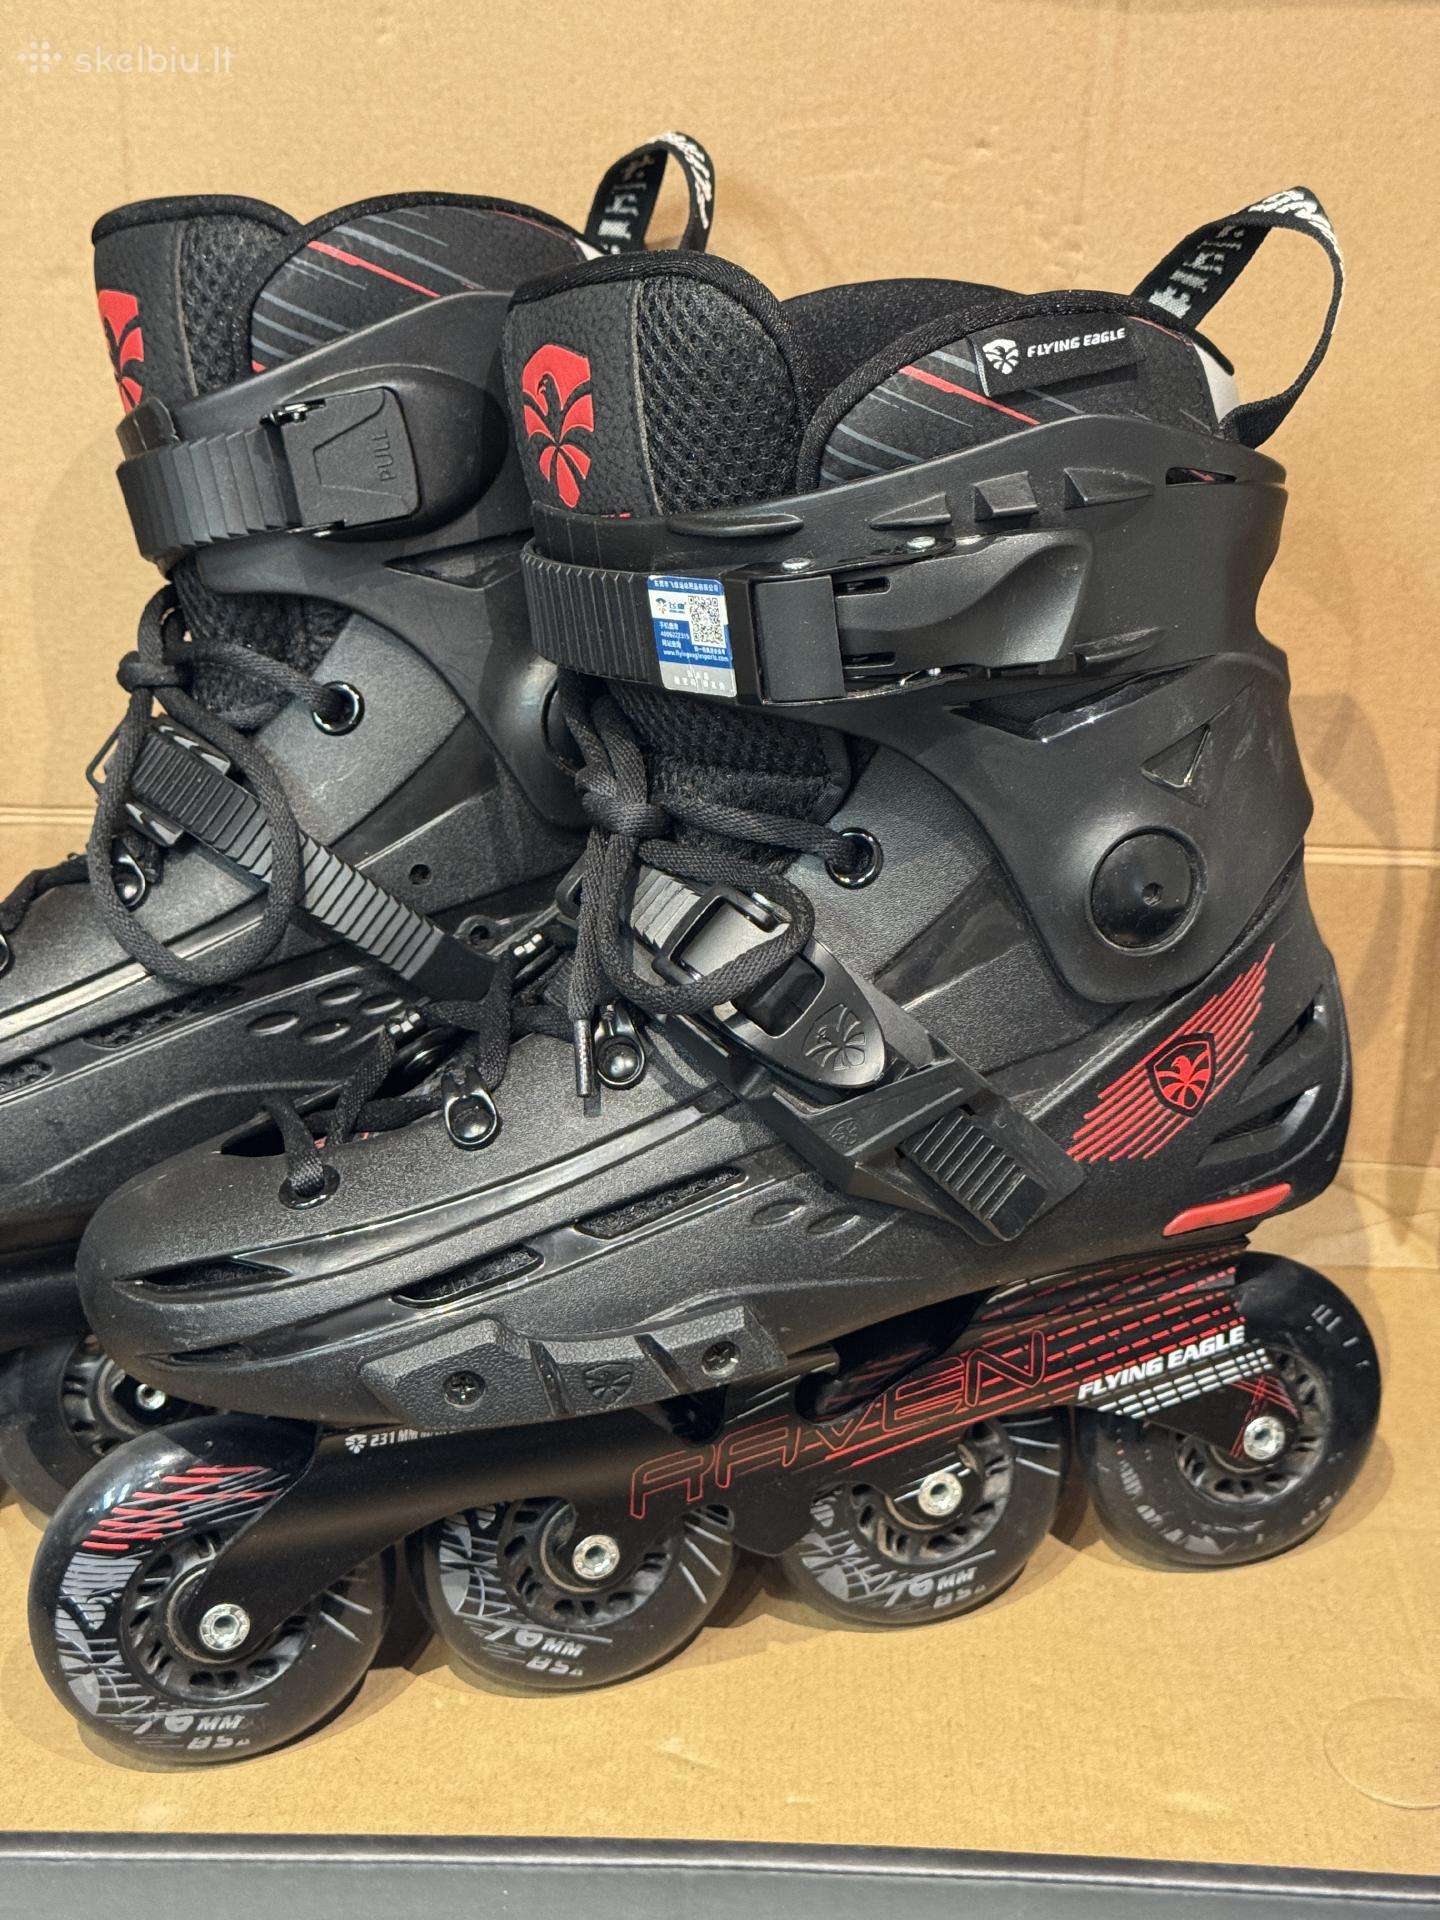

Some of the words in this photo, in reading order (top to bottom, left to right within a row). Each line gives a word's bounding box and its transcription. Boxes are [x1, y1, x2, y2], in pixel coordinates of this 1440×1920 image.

[1026, 335, 1081, 358] FLYING
[371, 427, 397, 482] PULL
[1077, 1355, 1165, 1400] FLYING
[1166, 1324, 1246, 1370] EAGLE
